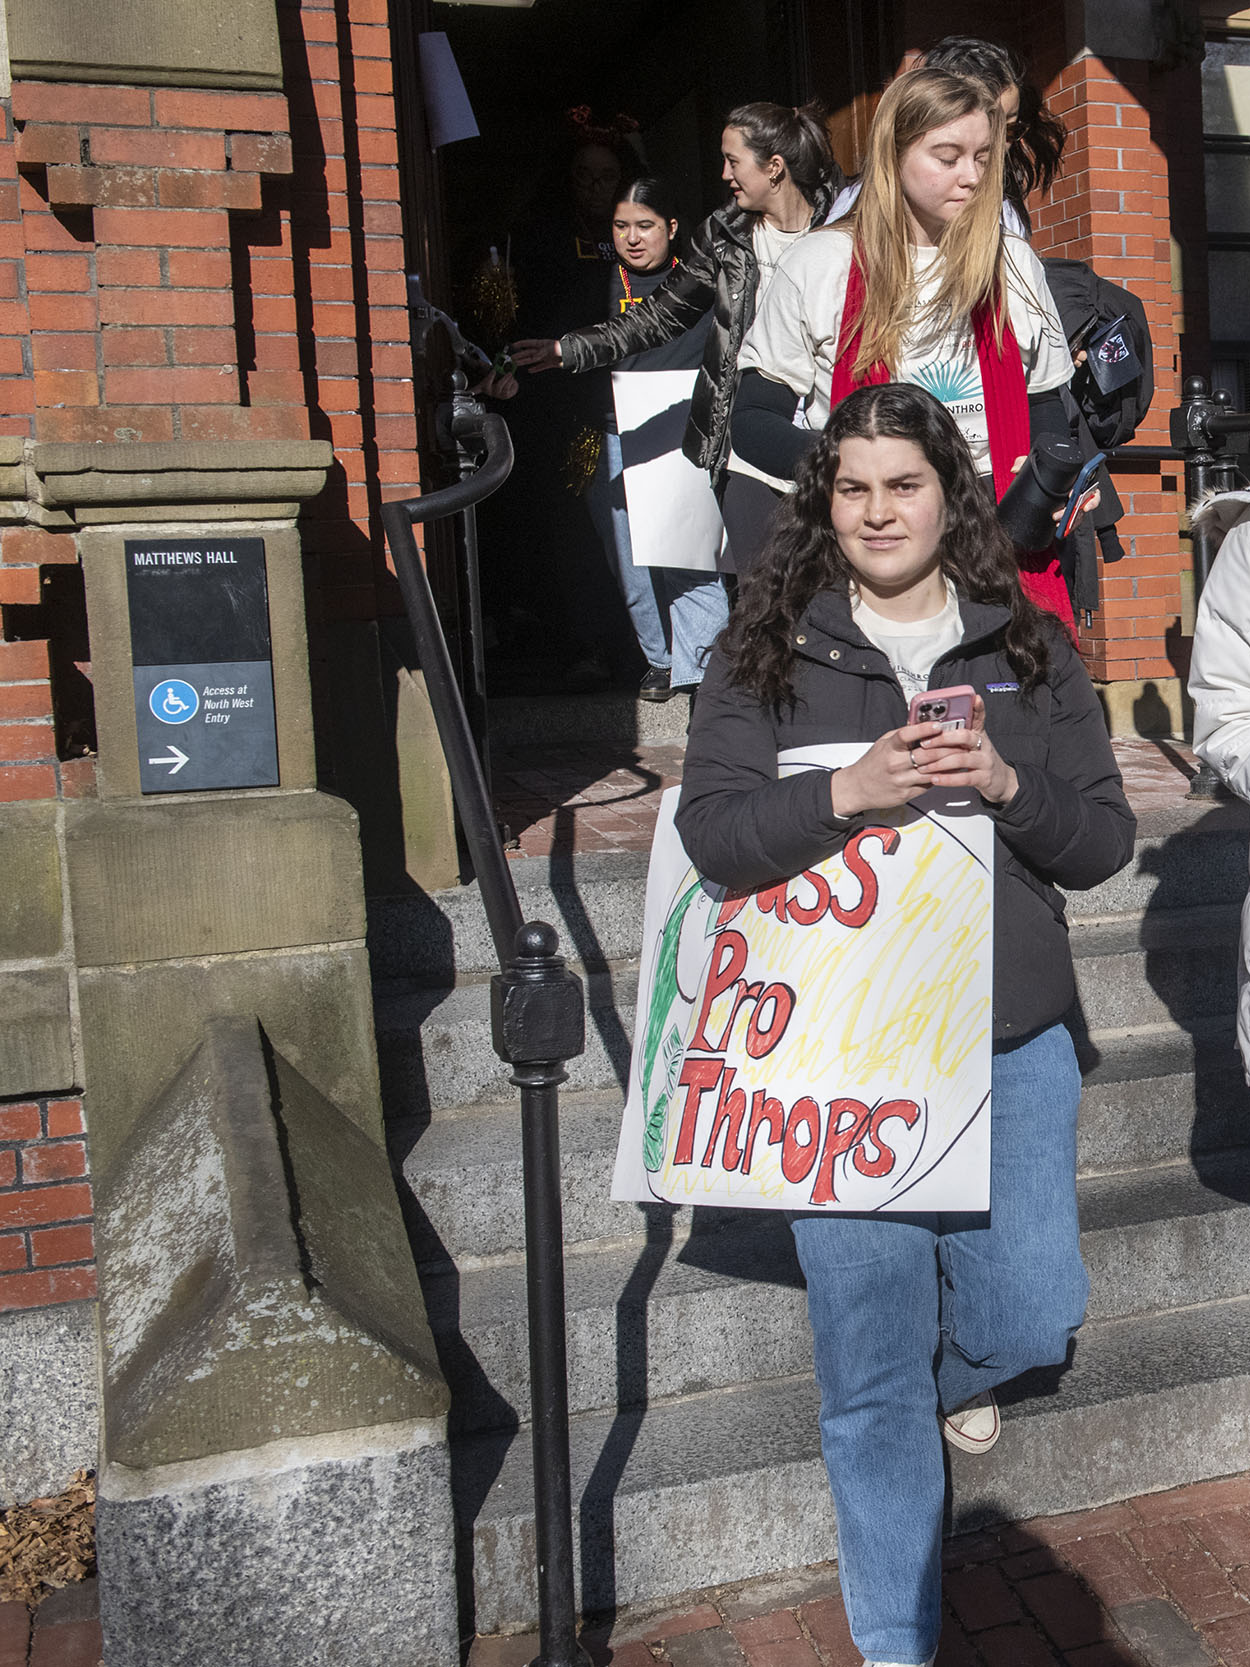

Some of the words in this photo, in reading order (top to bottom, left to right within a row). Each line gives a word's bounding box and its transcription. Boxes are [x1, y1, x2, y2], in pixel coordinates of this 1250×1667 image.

[134, 552, 202, 565] MATTHEWS
[206, 551, 238, 564] HALL
[203, 686, 235, 696] Access
[237, 684, 248, 695] at
[204, 699, 229, 710] North
[232, 698, 254, 709] West
[205, 713, 230, 724] Entry
[686, 929, 797, 1060] Pro
[673, 1057, 920, 1206] Throps
